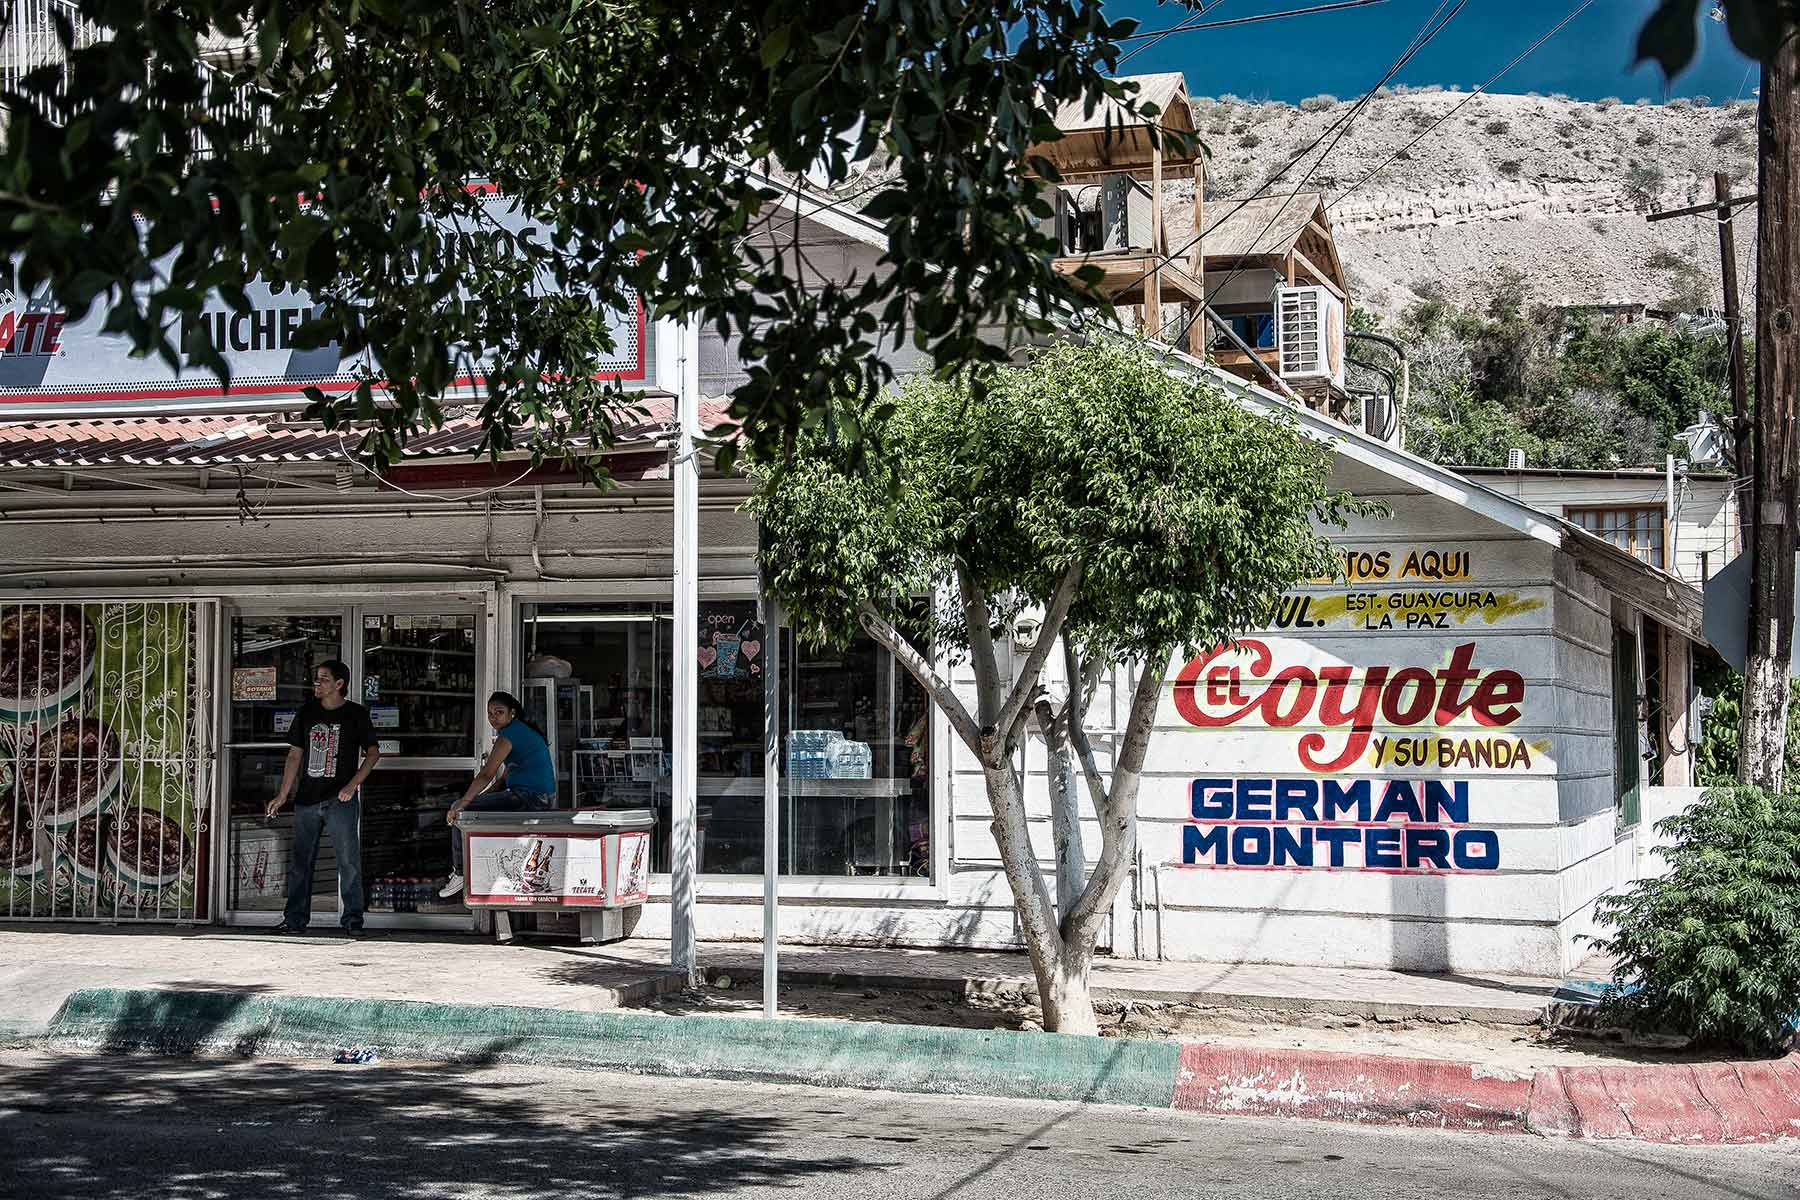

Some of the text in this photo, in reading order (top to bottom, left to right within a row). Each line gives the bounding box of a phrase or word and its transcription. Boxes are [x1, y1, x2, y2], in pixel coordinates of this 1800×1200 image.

[1402, 550, 1471, 579] AQUI
[1346, 593, 1382, 611] EST.
[1388, 591, 1497, 609] GUAYCURA
[707, 614, 735, 629] open
[1366, 612, 1450, 629] LA PAZ
[1173, 638, 1525, 773] EL Coyote
[1373, 738, 1532, 769] Y SU BANDA
[1190, 778, 1470, 823] GERMAN
[1181, 825, 1500, 870] MONTERO
[572, 886, 596, 894] TECATE
